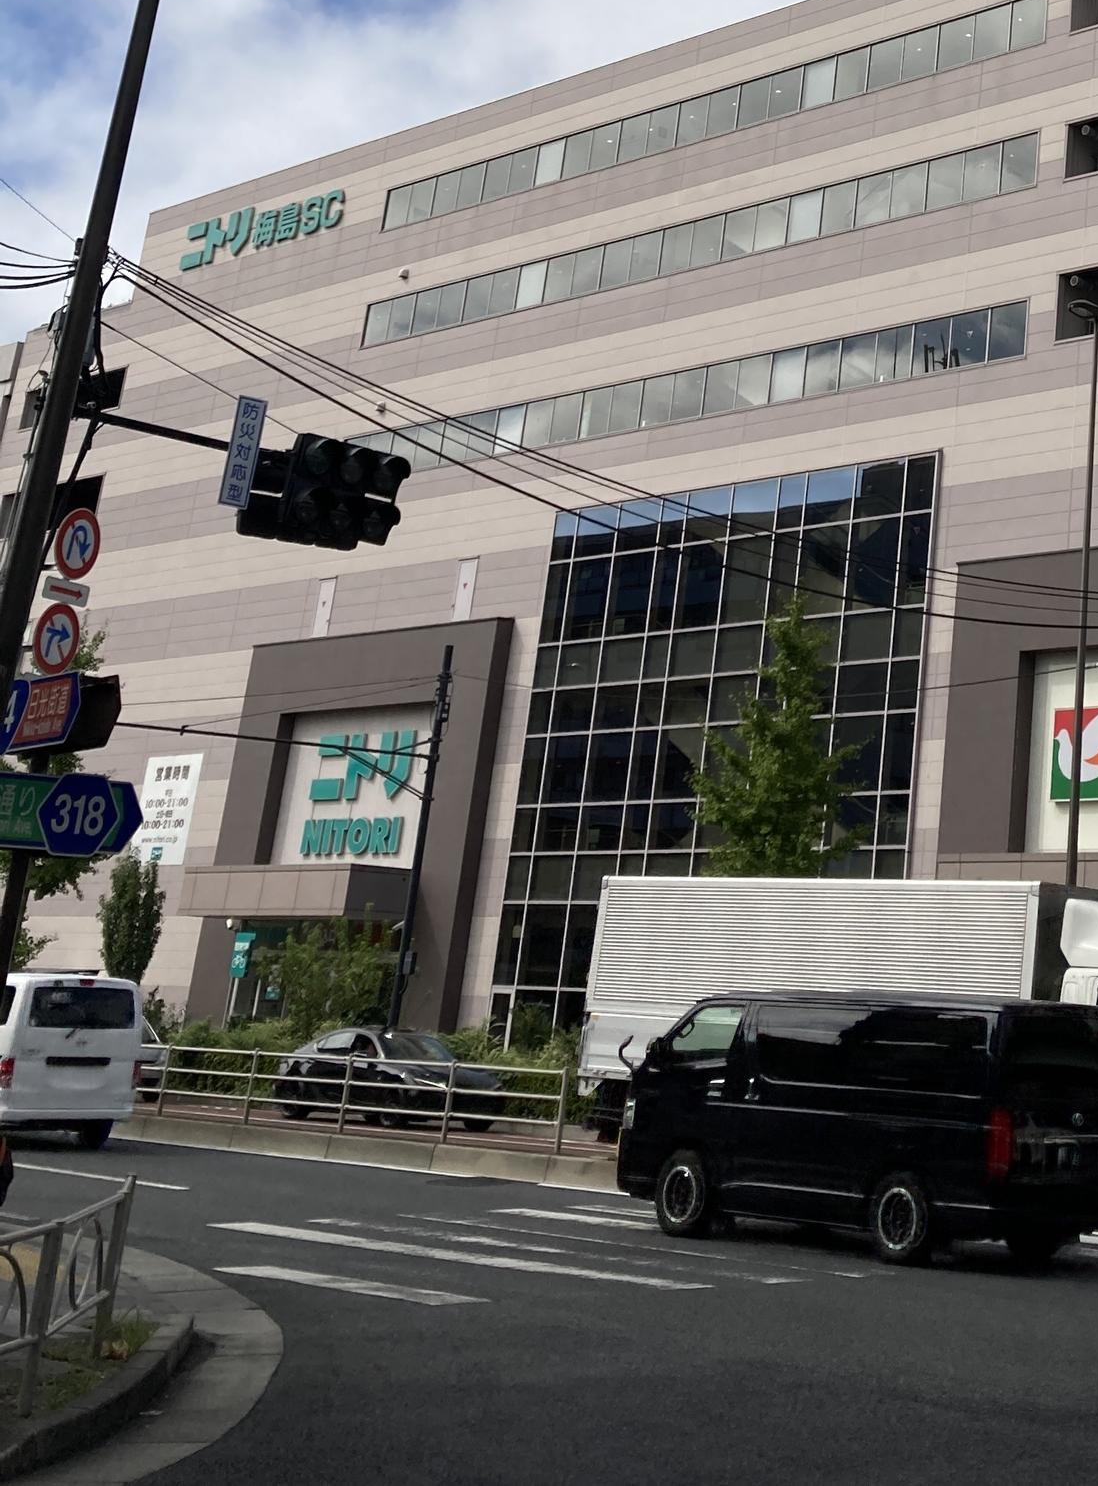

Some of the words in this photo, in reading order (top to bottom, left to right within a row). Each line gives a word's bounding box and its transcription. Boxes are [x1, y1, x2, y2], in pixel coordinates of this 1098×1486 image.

[226, 402, 259, 502] 防災対応型
[309, 730, 417, 800] ニトリ
[51, 794, 106, 836] 318
[301, 816, 405, 856] NITORI
